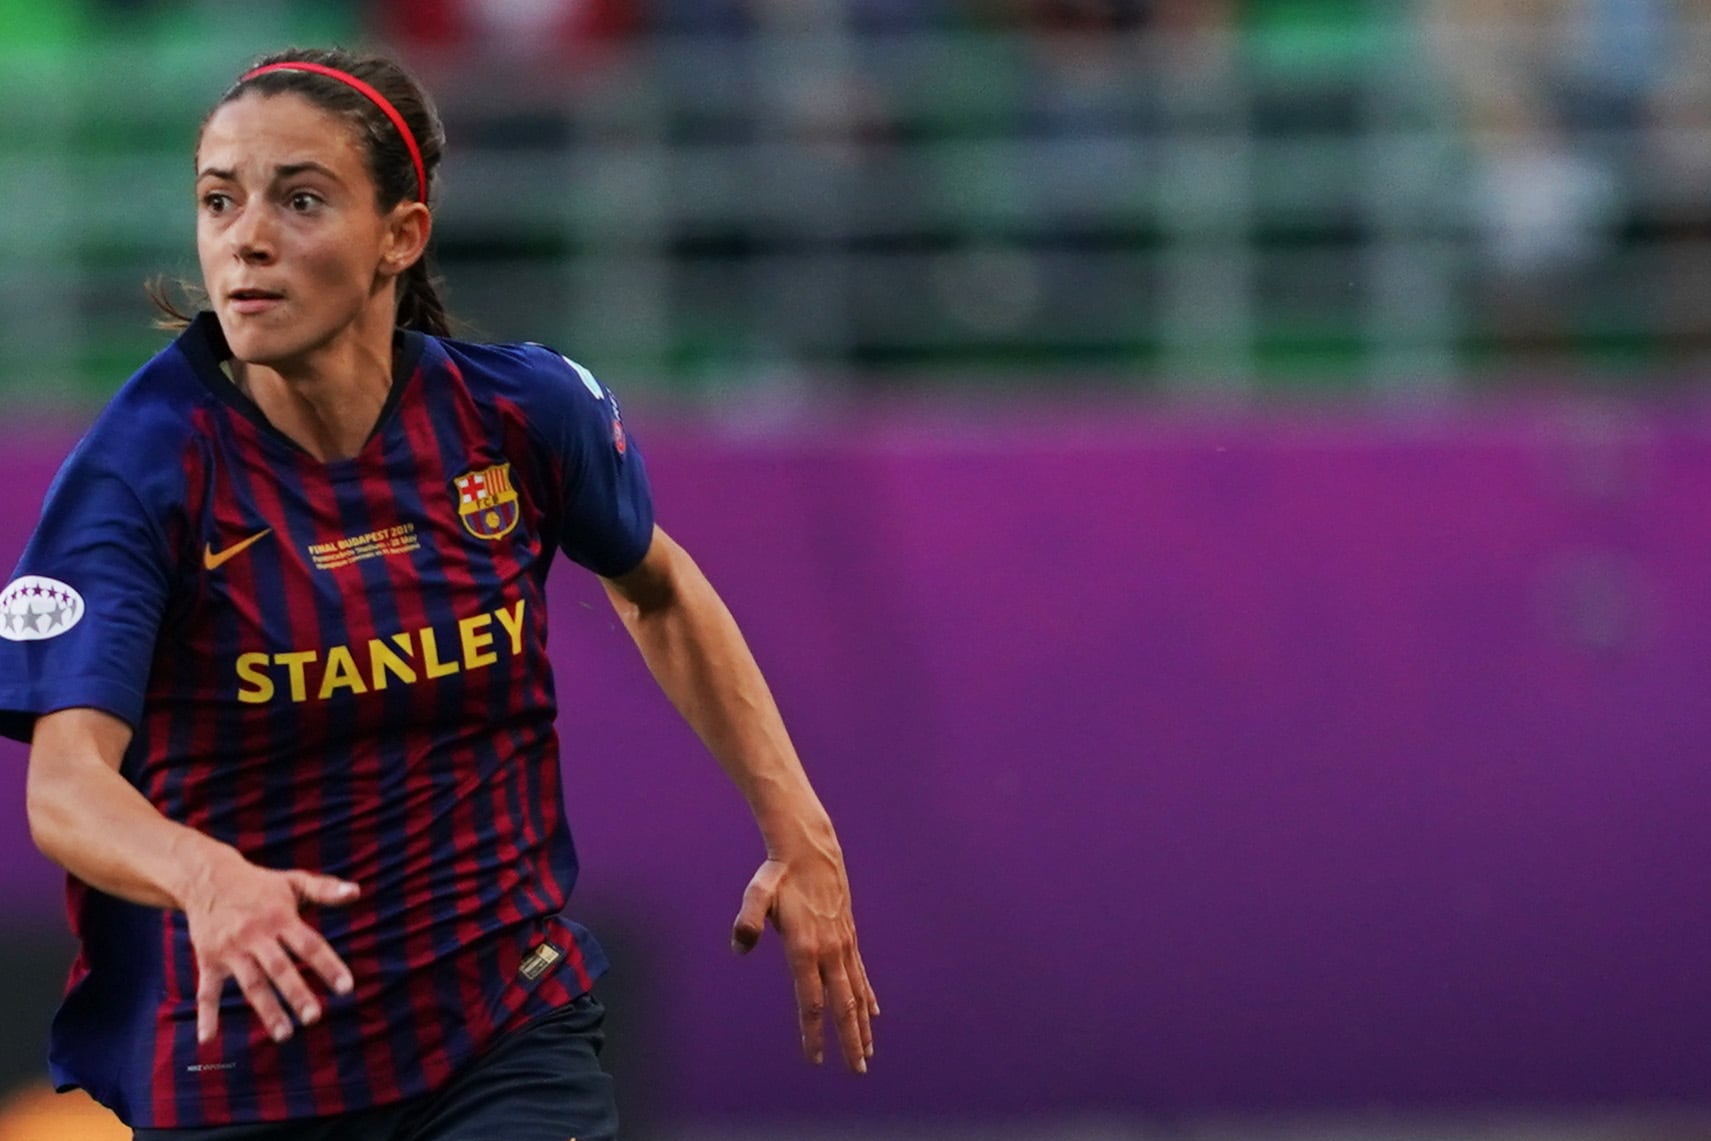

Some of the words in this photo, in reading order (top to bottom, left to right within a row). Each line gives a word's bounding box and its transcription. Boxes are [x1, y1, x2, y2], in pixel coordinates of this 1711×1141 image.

[308, 542, 338, 555] FINAL
[337, 529, 389, 550] BUDAPEST
[391, 523, 414, 537] 2019
[236, 599, 526, 704] STANLEY
